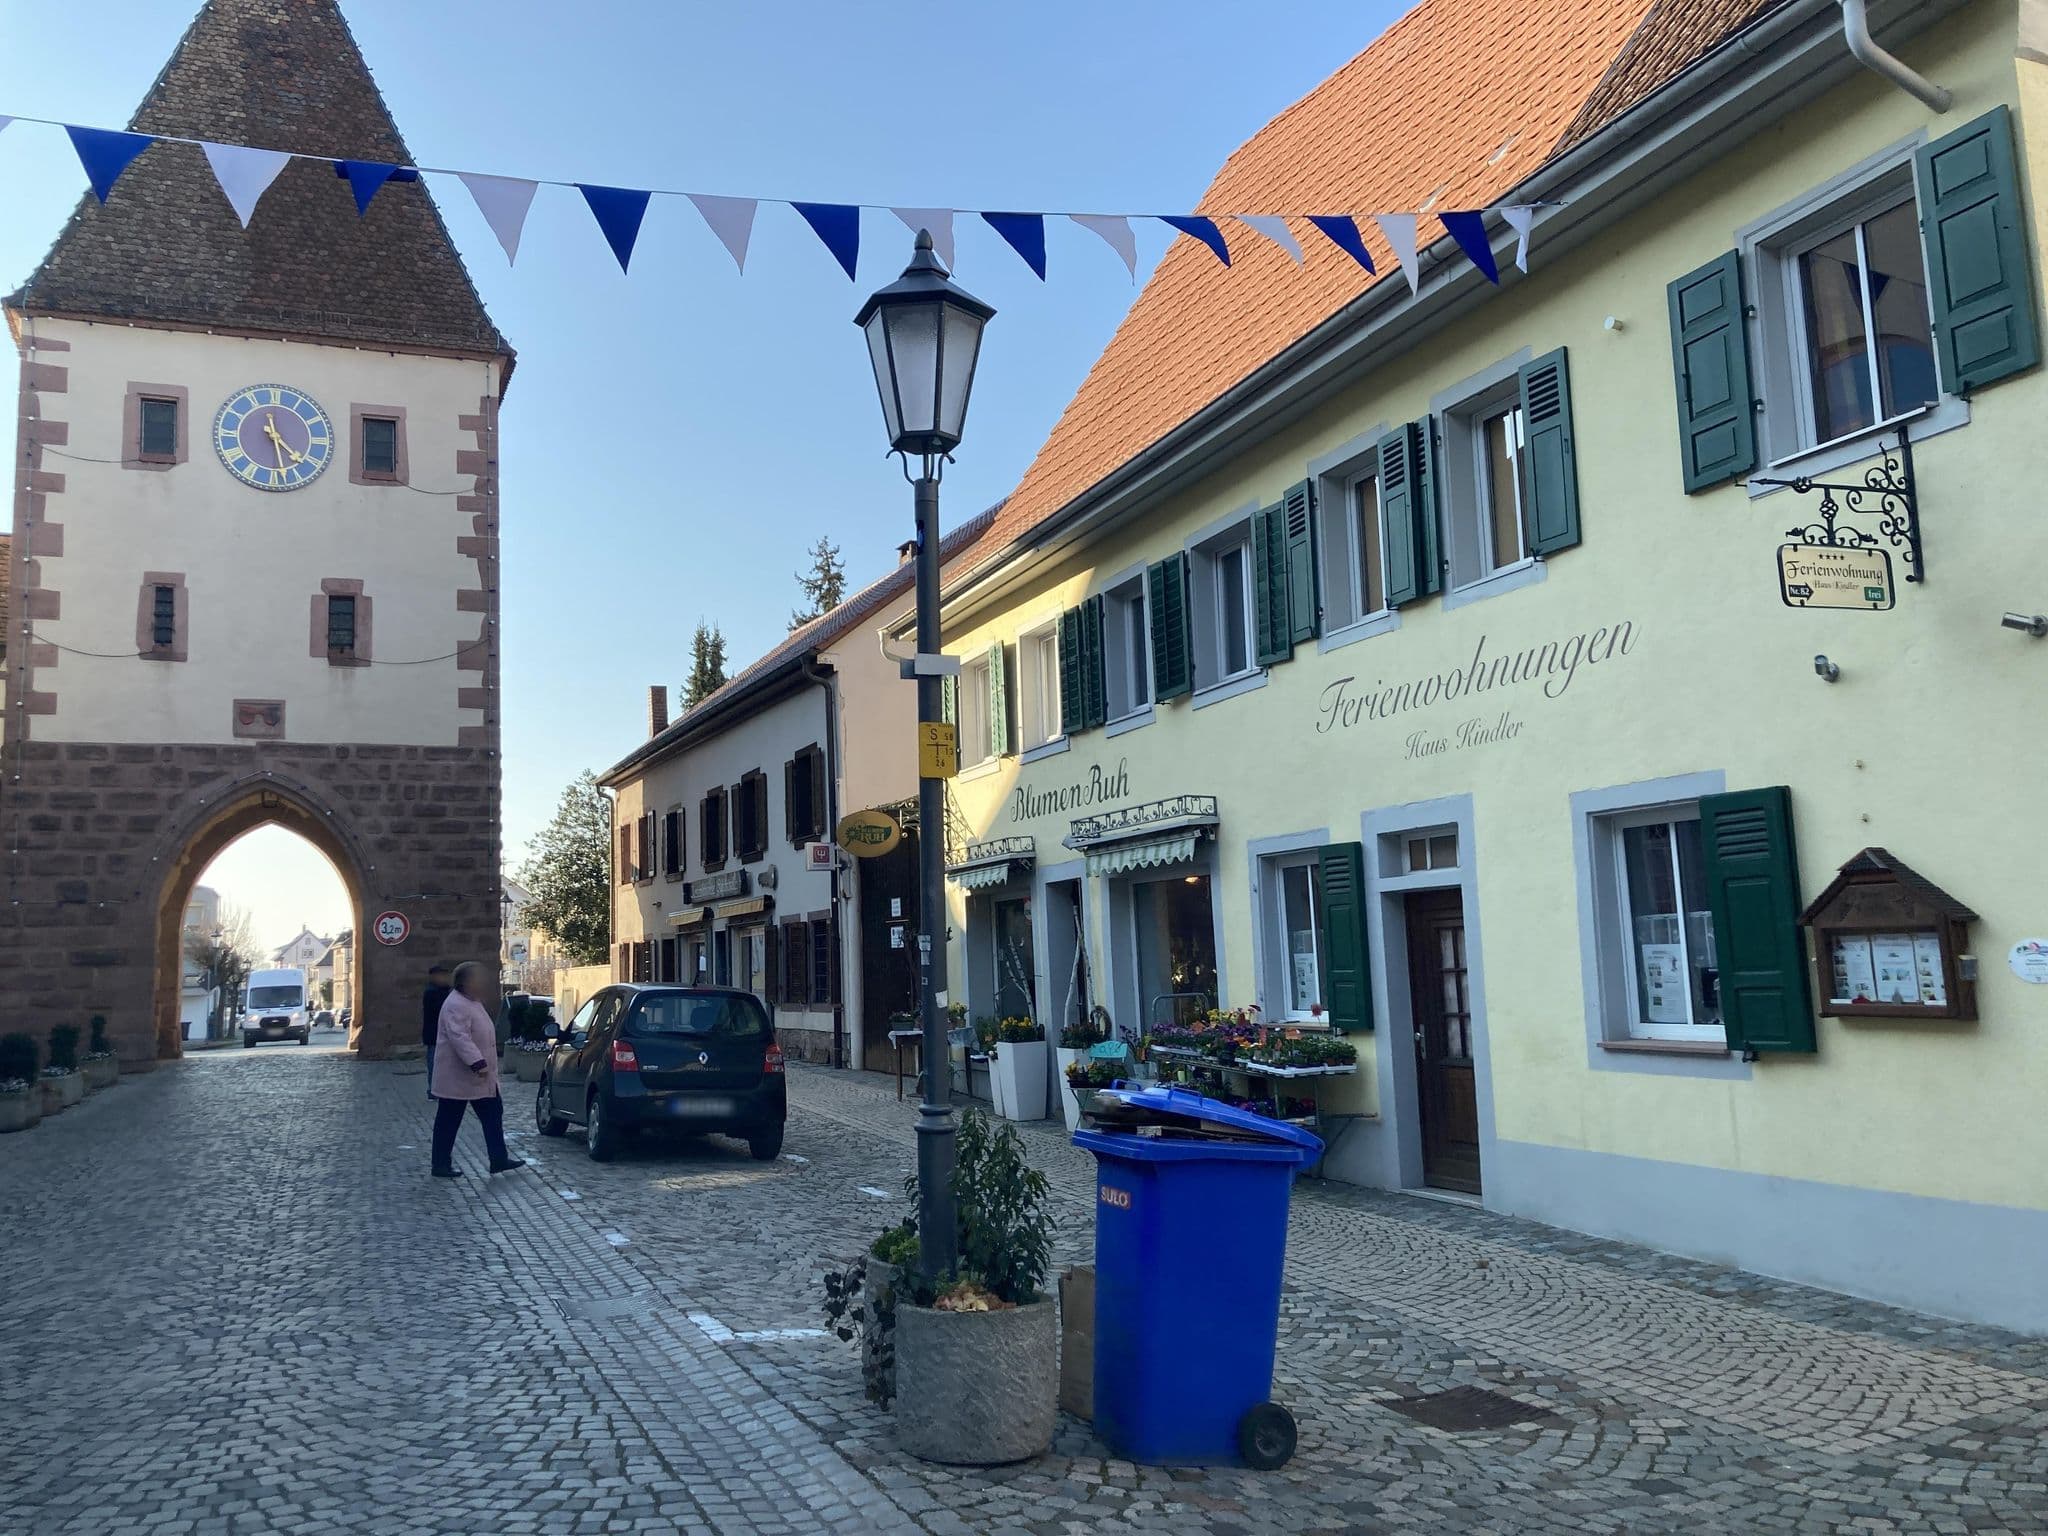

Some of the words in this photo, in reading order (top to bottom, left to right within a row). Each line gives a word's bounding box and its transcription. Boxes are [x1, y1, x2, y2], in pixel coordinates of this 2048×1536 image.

[1785, 561, 1883, 585] Ferienwohnung
[1316, 620, 1642, 734] Ferienwohnungen
[930, 728, 938, 740] S
[1404, 730, 1448, 760] Haus
[1456, 712, 1526, 750] Kindler
[1101, 1186, 1129, 1207] SULO
